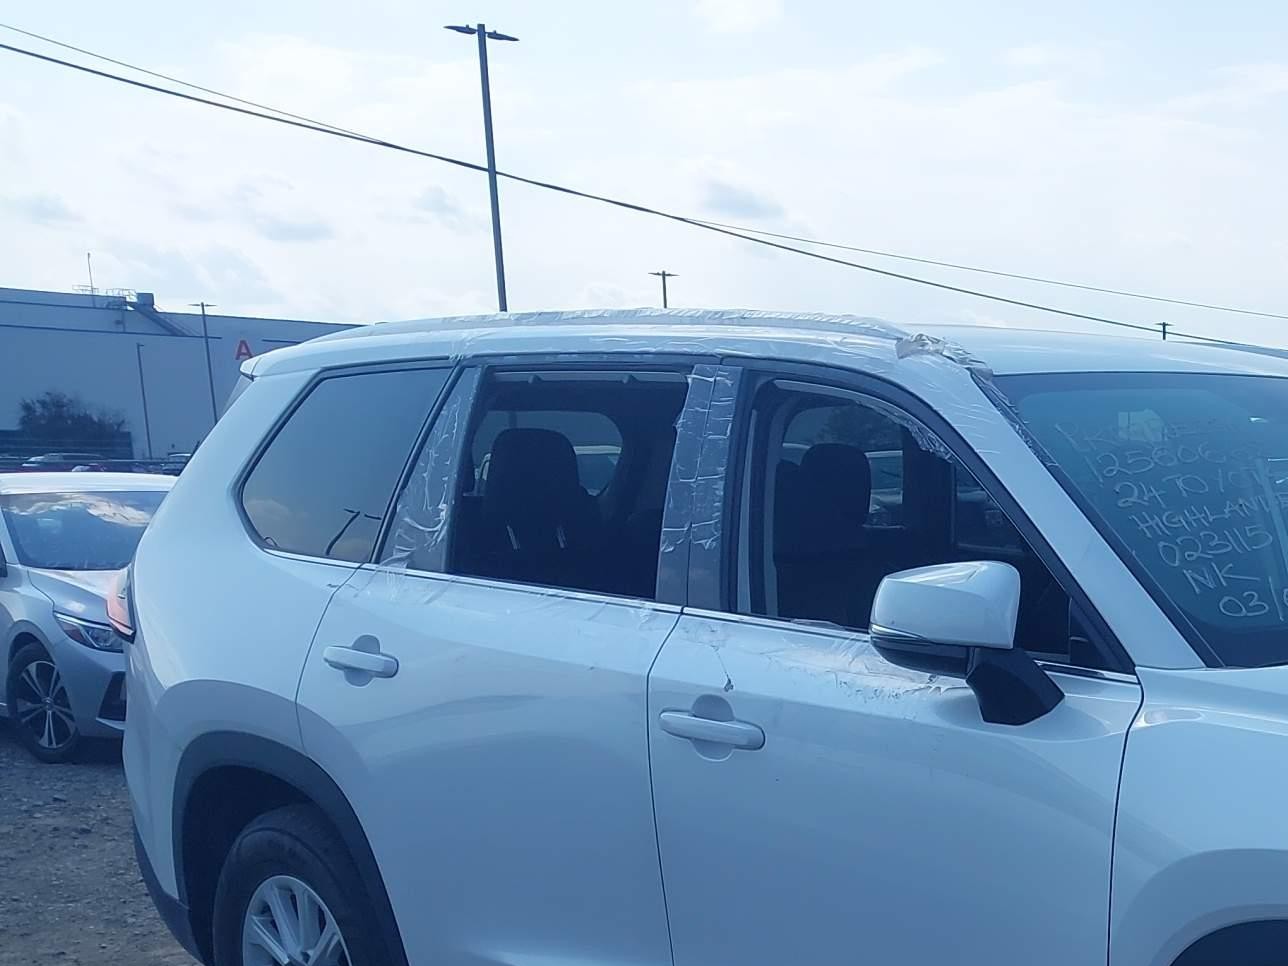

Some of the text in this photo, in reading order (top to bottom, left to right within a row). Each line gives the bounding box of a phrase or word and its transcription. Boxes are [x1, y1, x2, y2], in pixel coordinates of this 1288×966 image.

[235, 339, 253, 360] A
[1113, 481, 1167, 509] 24
[1157, 524, 1273, 567] 023115
